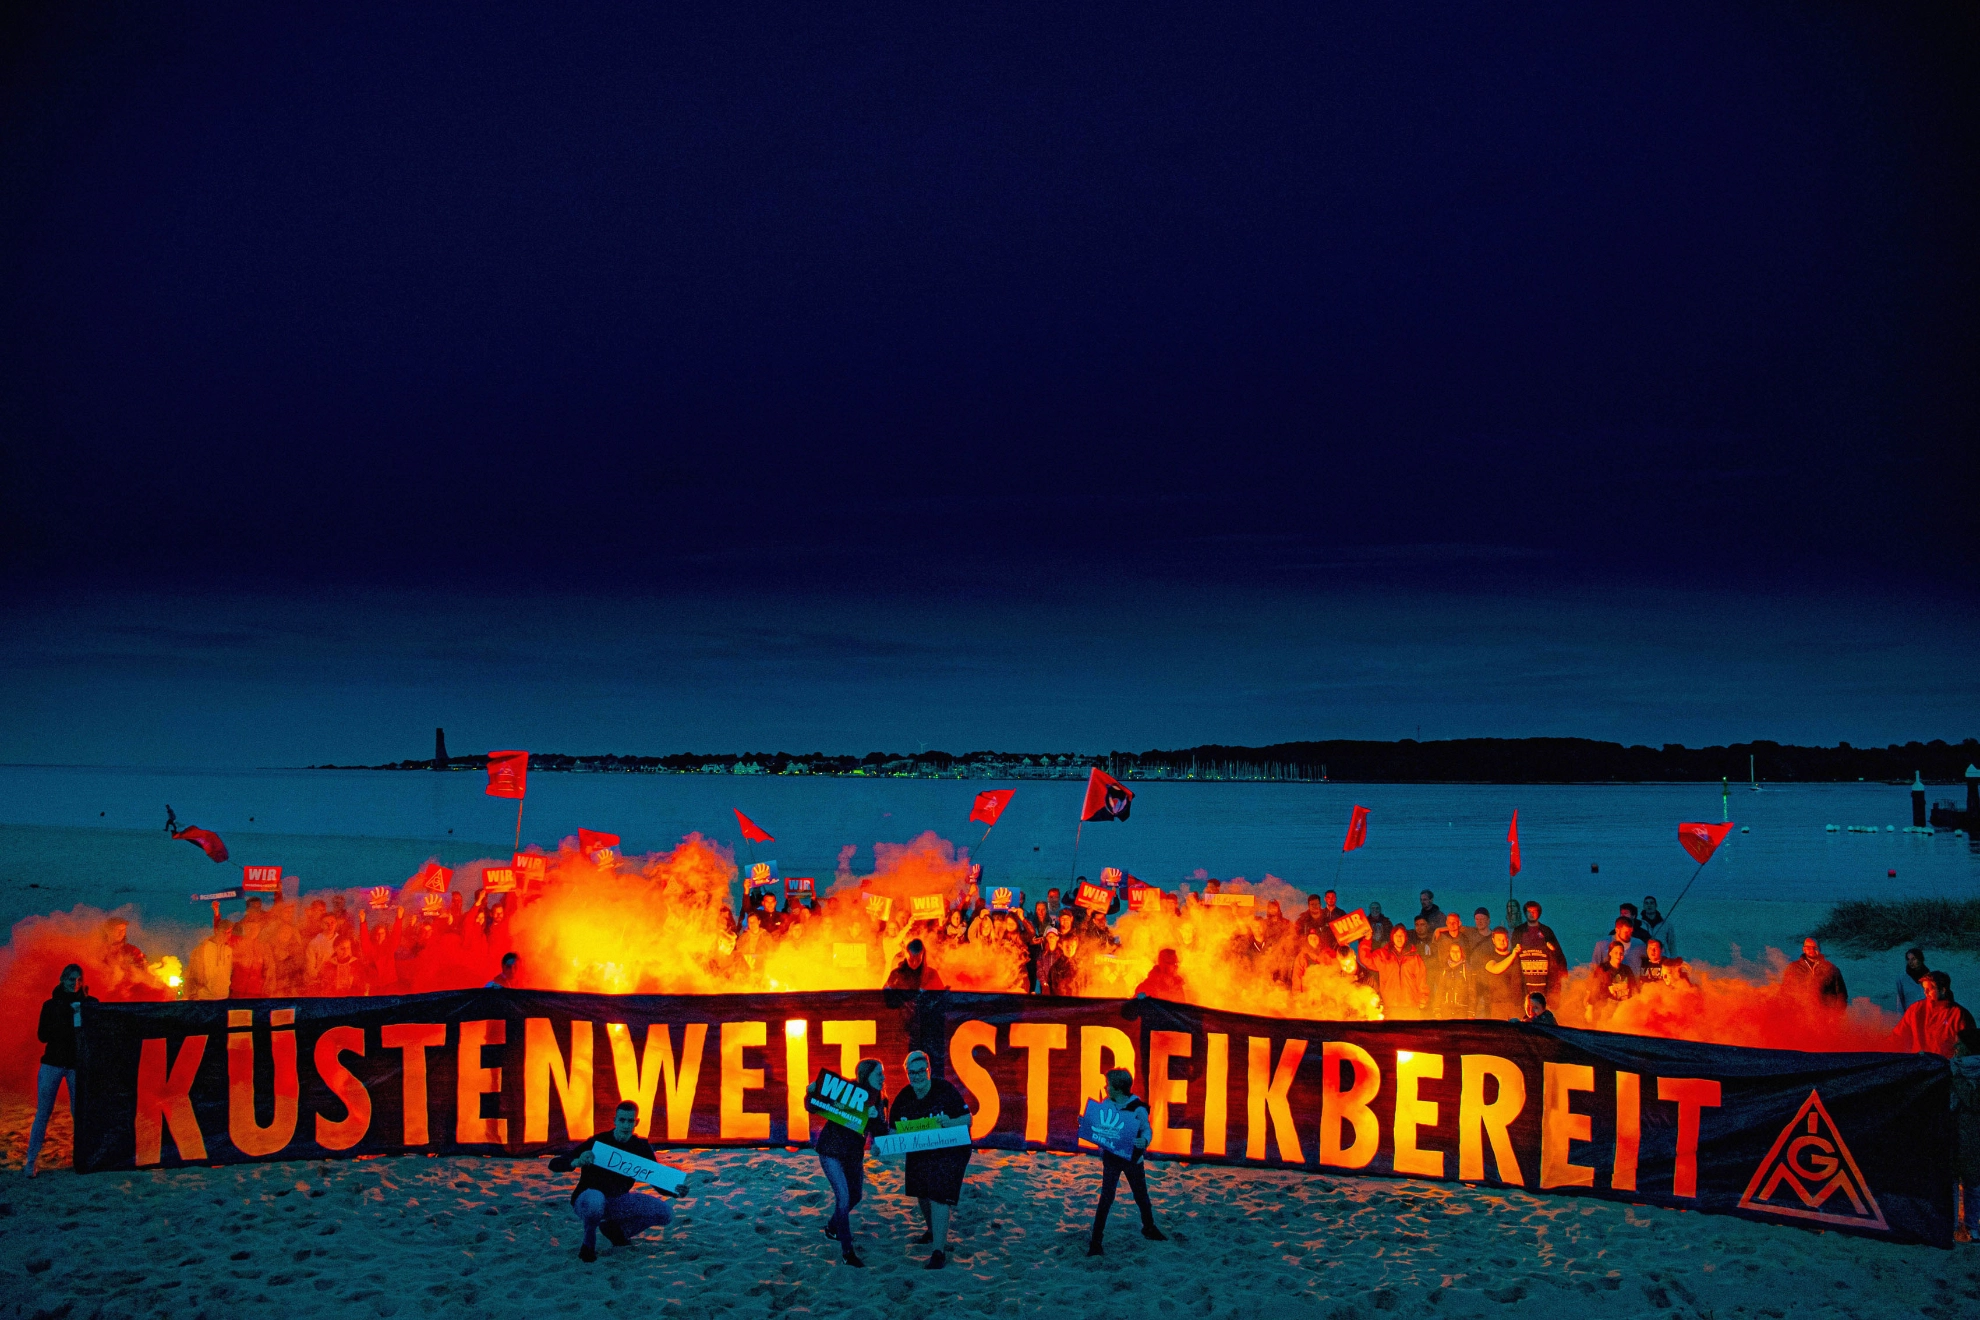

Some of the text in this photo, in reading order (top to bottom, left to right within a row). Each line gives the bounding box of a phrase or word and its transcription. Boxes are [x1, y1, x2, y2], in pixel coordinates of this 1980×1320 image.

[516, 855, 542, 869] WIR
[248, 868, 277, 881] WIR
[486, 869, 513, 882] WIR
[788, 879, 811, 891] WIR
[1082, 885, 1108, 903] WIR
[913, 896, 939, 910] WIR
[1333, 913, 1363, 934] WIR
[820, 1073, 869, 1112] WIR
[135, 1009, 1722, 1198] KÜSTENWEIT STREIKBEREIT
